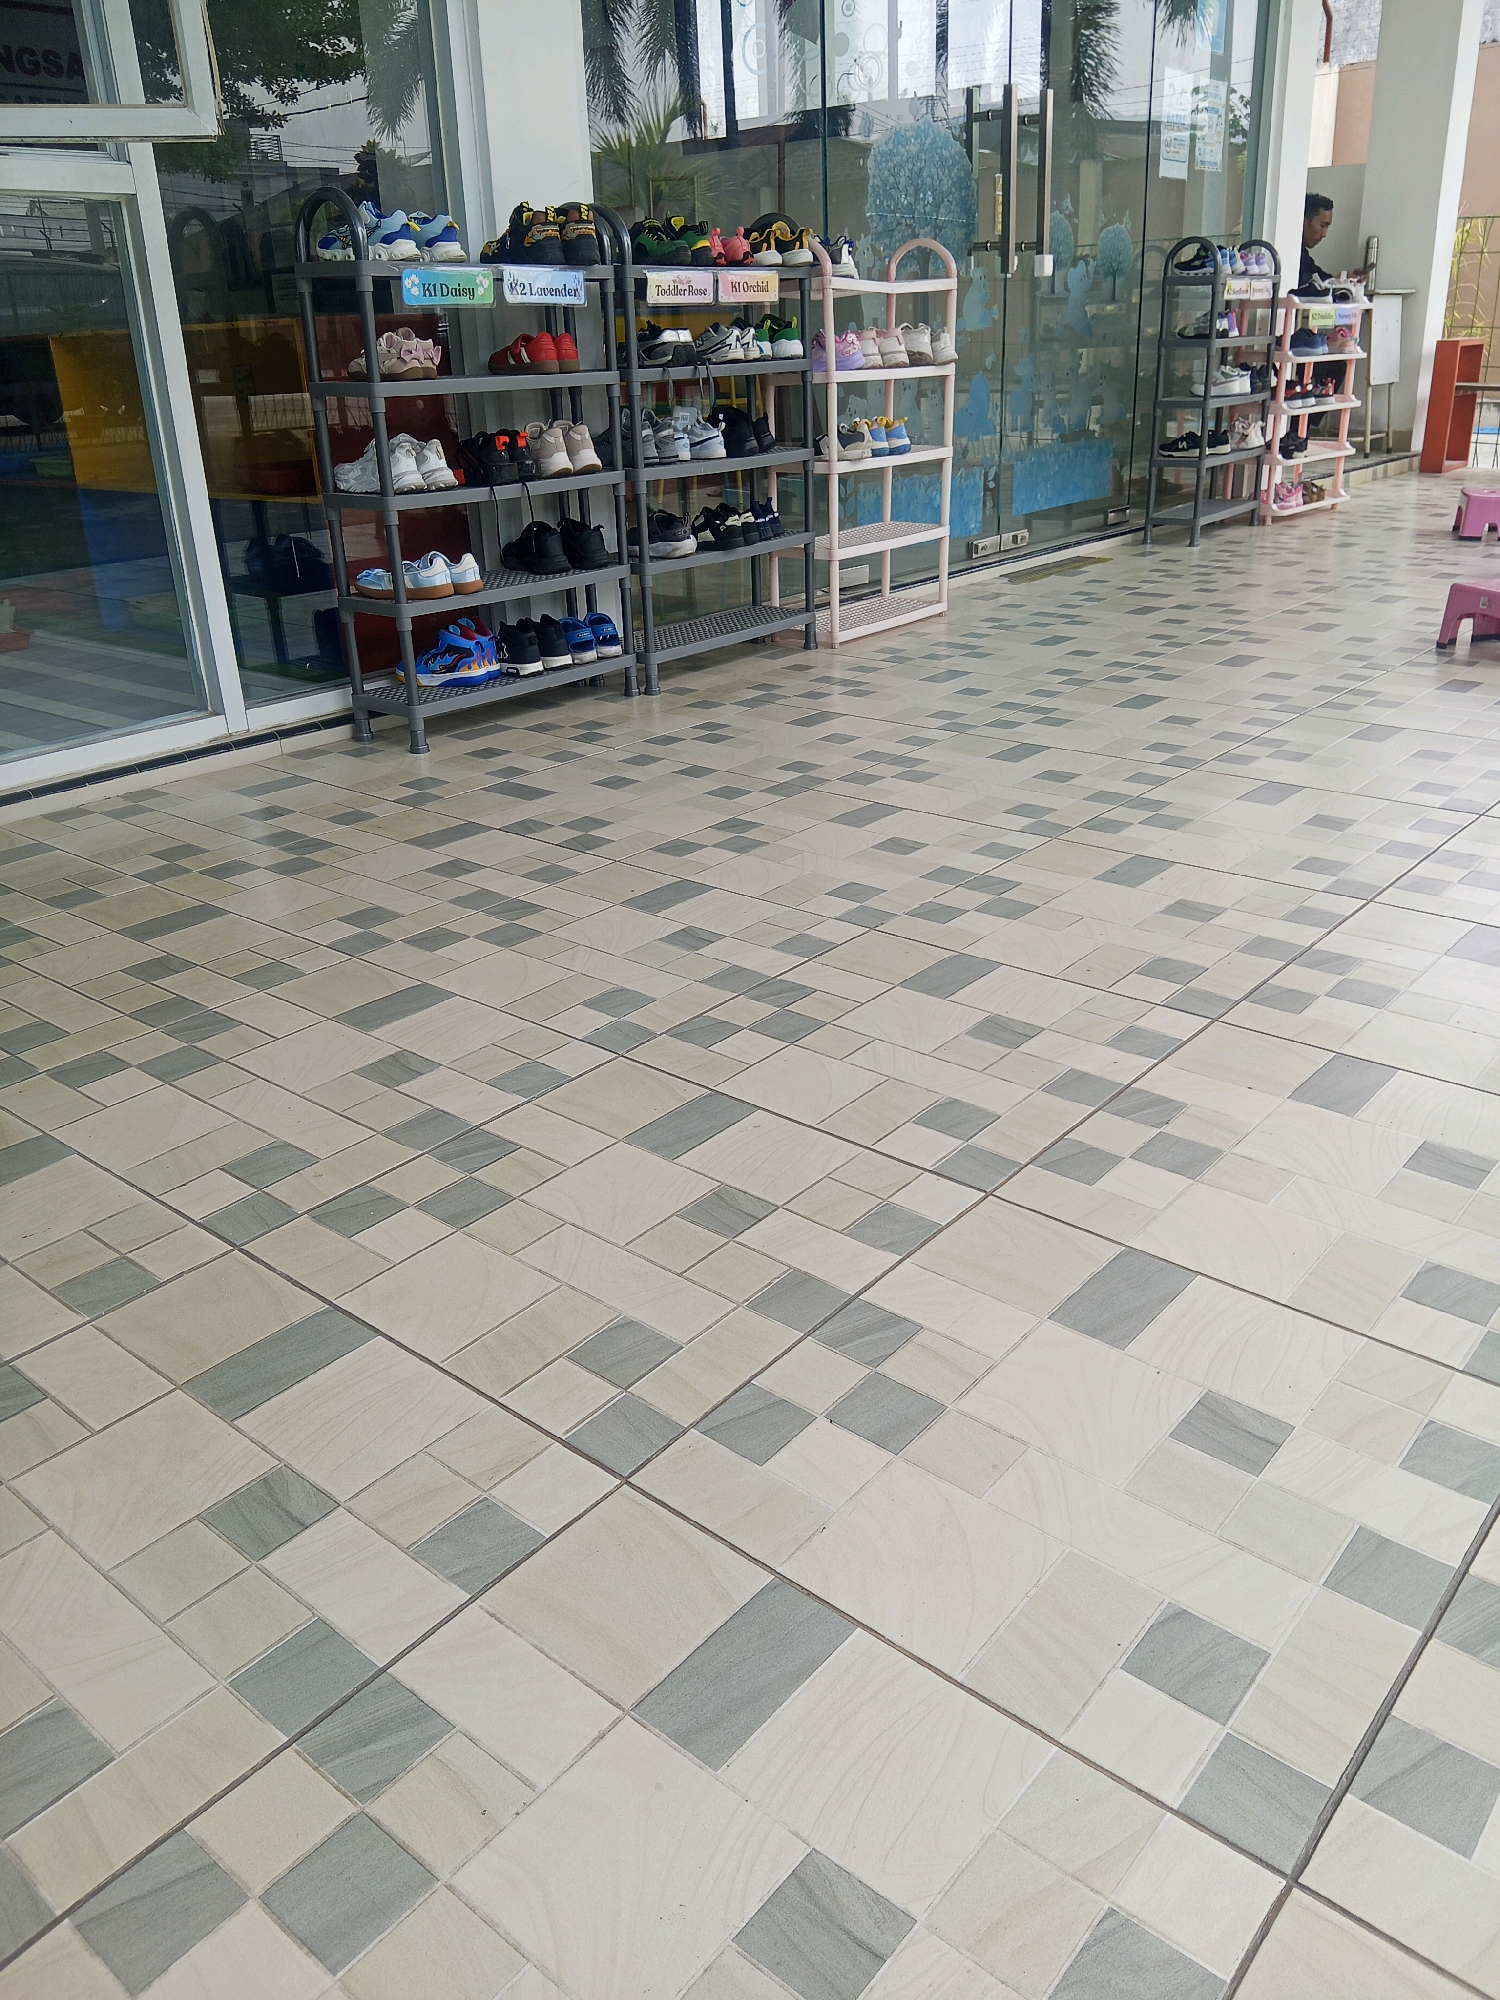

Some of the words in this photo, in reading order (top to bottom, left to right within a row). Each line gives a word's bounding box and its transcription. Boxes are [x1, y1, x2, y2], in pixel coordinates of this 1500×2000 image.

[422, 283, 437, 297] K1
[440, 283, 475, 300] Daisy
[510, 282, 527, 296] K2
[530, 283, 579, 298] Lavender
[655, 285, 687, 296] Toddler
[688, 285, 707, 296] Rose
[731, 282, 741, 292] K1
[743, 281, 769, 292] Orchid
